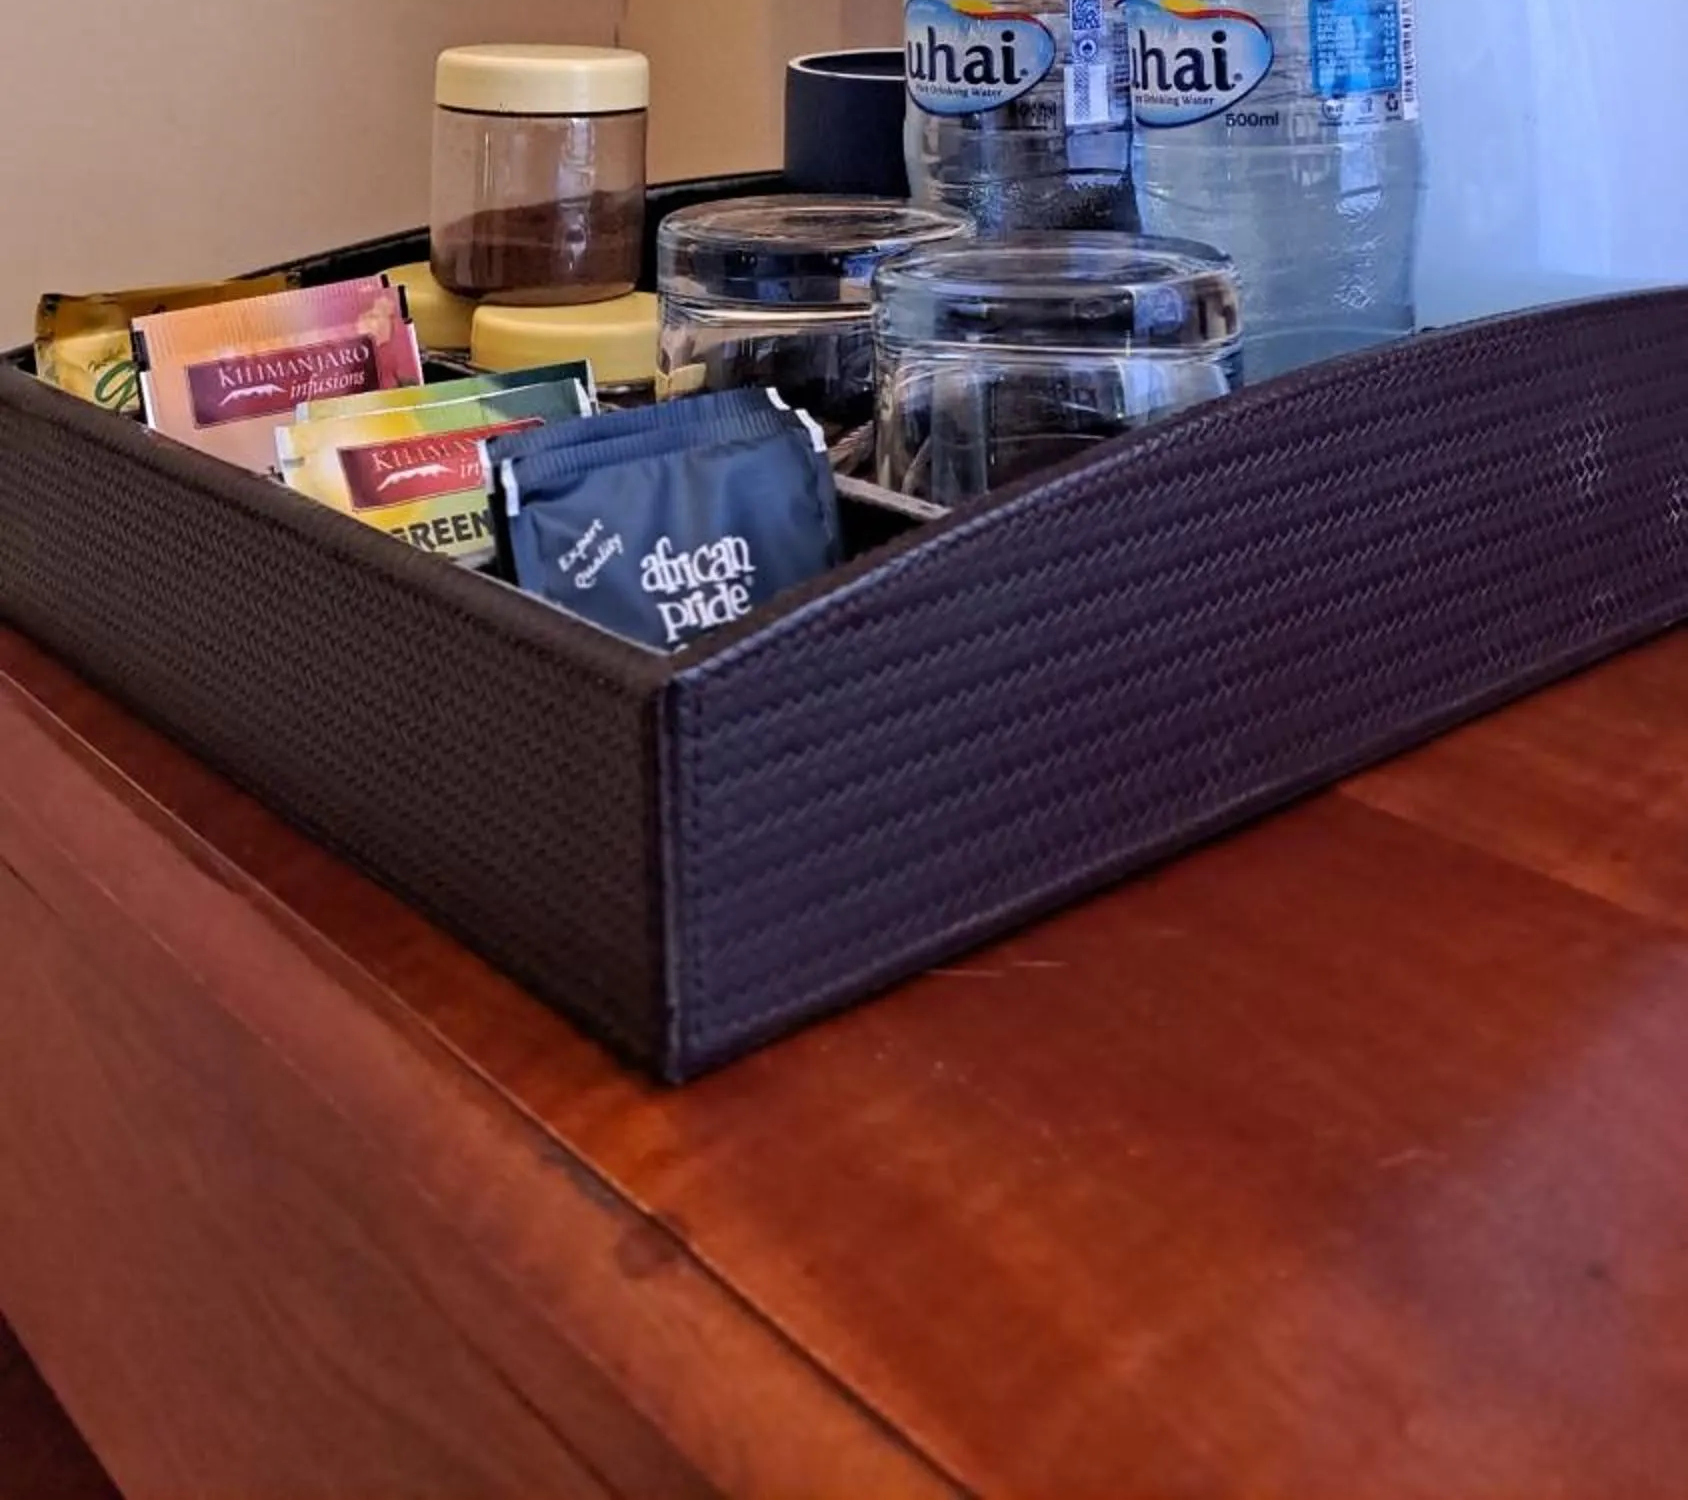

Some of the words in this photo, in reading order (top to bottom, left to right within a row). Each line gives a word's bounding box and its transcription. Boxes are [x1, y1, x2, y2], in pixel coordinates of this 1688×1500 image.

[971, 86, 1003, 100] Water
[1225, 112, 1279, 127] 500ml
[217, 342, 370, 388] KILIMANJARO
[289, 369, 366, 401] infusions
[558, 518, 604, 573] Export
[574, 534, 624, 589] Quality
[640, 536, 757, 595] african
[656, 583, 751, 643] pride
